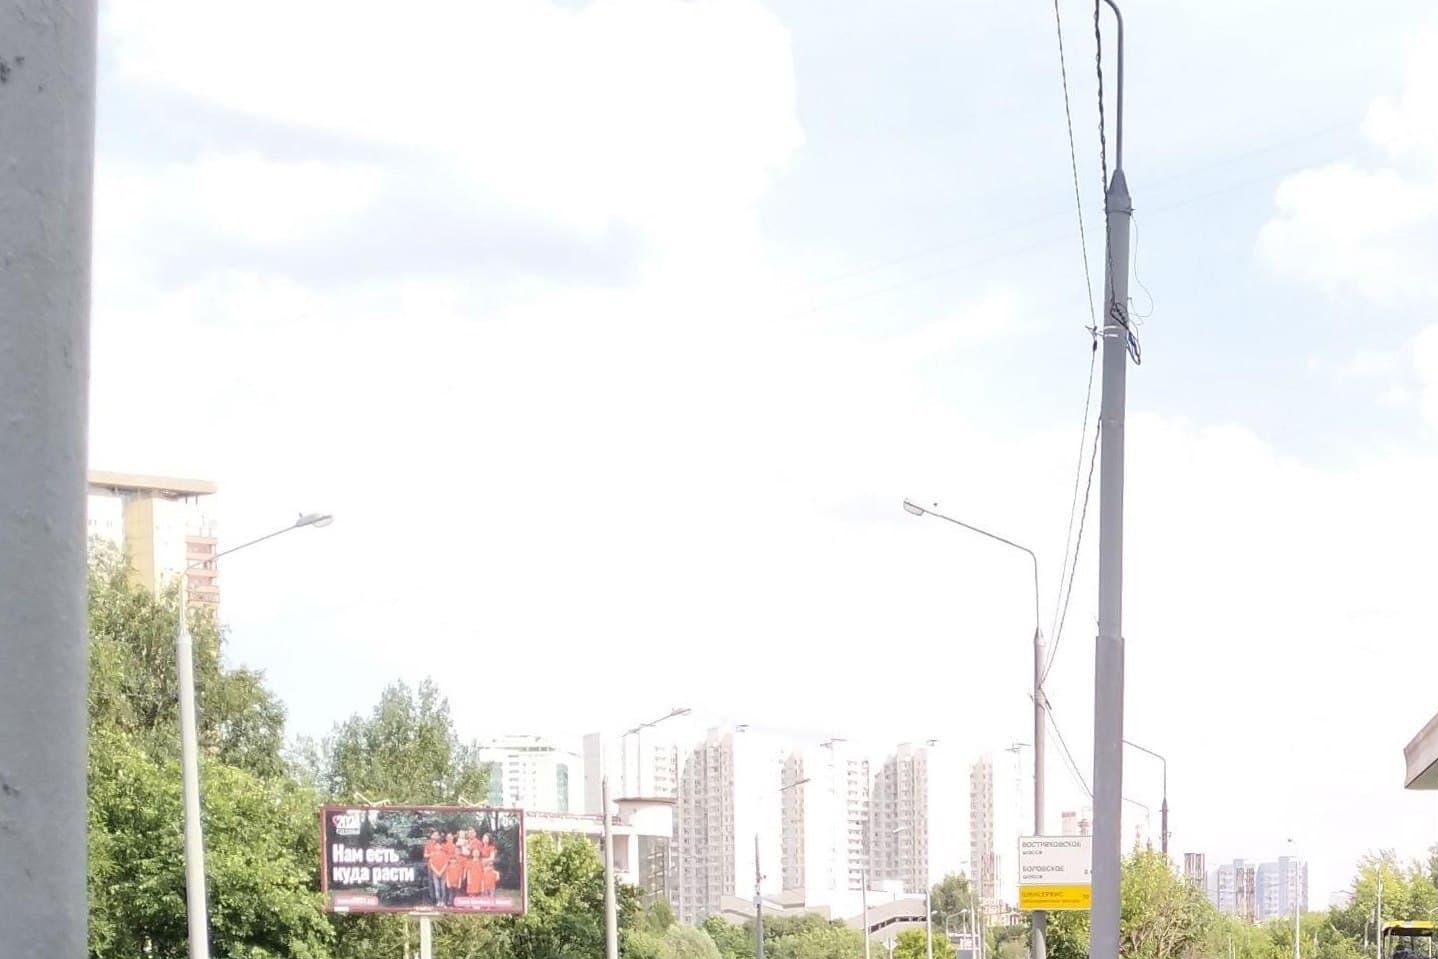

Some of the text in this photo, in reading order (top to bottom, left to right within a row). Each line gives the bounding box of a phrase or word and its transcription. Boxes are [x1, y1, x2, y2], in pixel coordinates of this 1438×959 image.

[332, 843, 400, 863] Нам есть
[332, 867, 416, 884] куда расти
